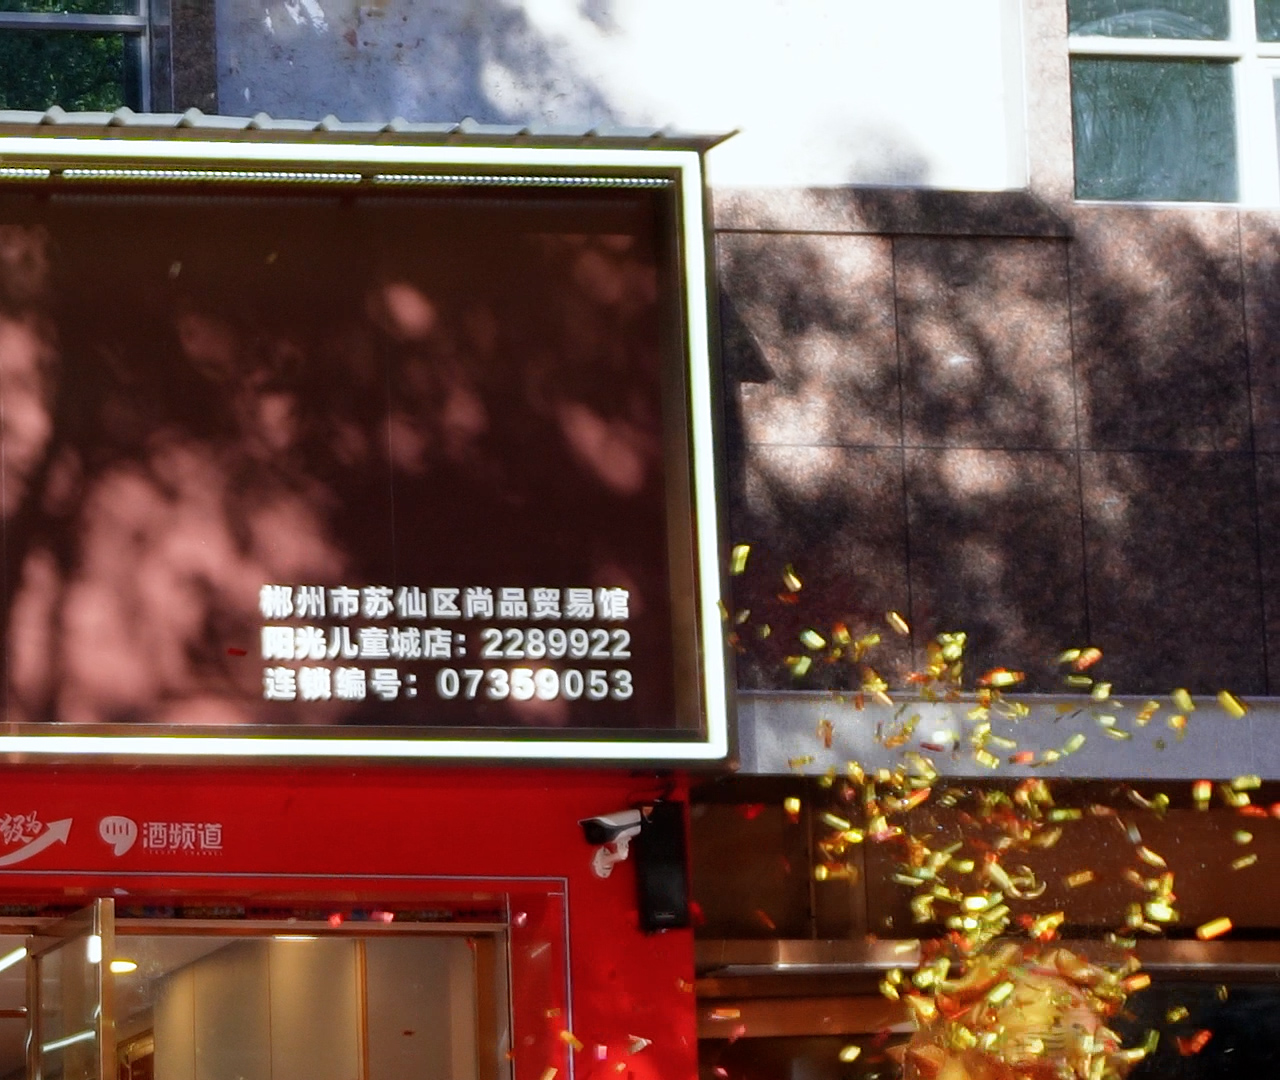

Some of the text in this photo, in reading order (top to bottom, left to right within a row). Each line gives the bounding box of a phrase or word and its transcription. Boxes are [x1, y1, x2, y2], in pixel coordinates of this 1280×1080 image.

[258, 584, 631, 621] 郴州市苏仙区尚品贸易馆
[142, 821, 224, 850] 酒频道
